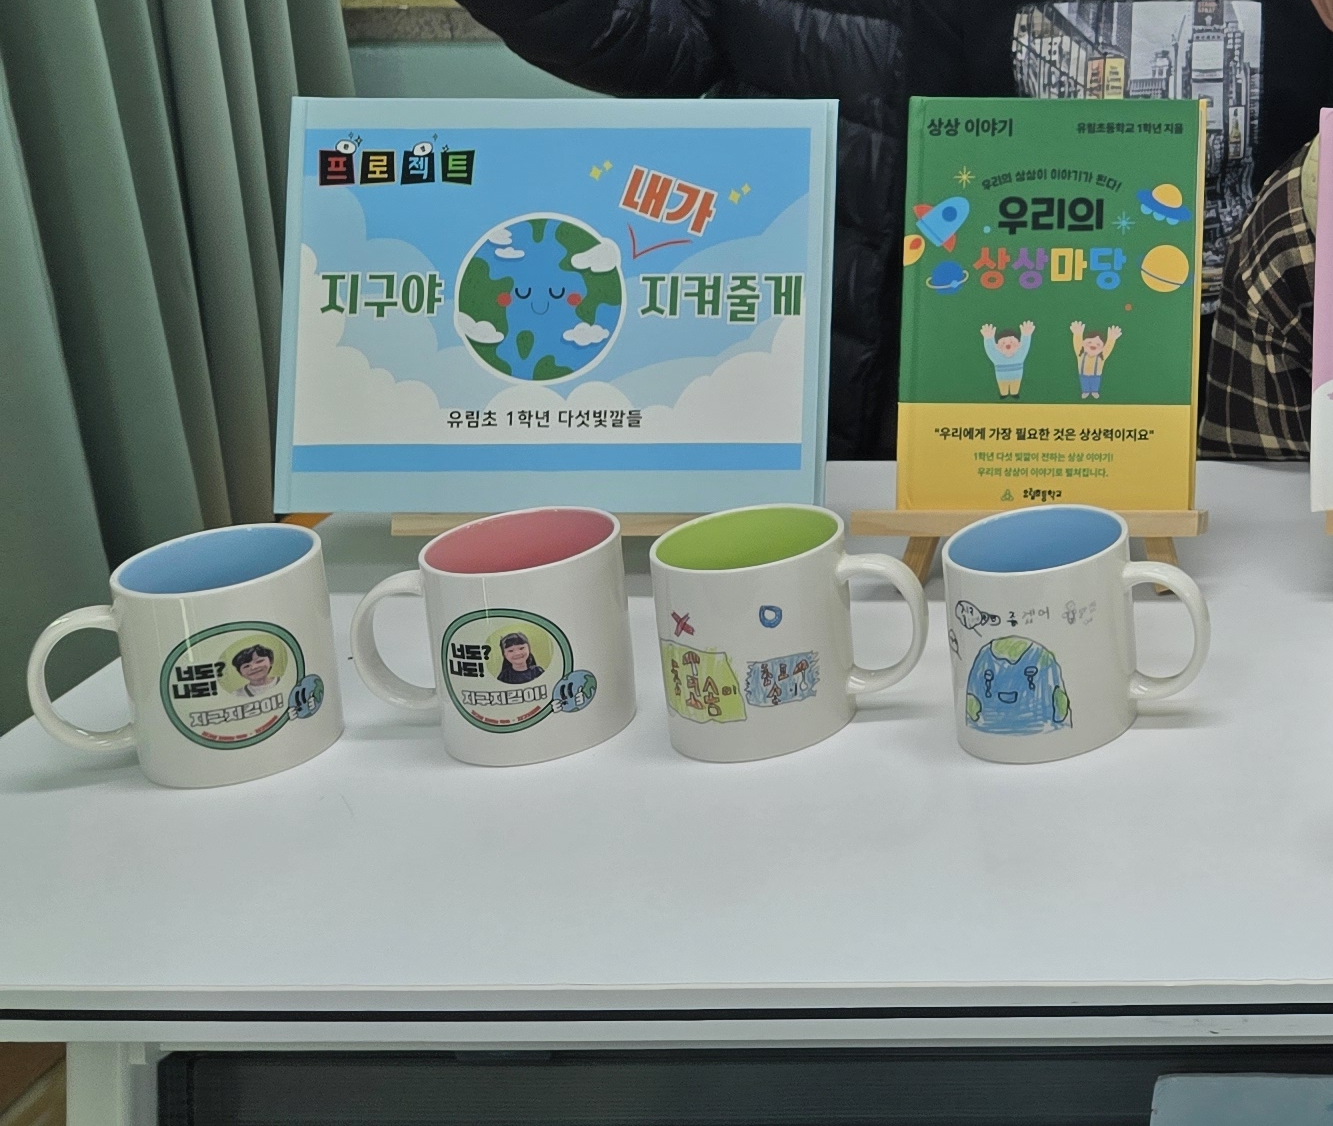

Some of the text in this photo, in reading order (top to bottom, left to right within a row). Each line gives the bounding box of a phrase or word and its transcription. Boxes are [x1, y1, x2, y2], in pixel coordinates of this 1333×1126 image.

[927, 118, 1013, 137] 상상 이야기
[1137, 122, 1162, 134] 1학년
[326, 154, 468, 180] 프로젝트
[982, 172, 1013, 191] 우리의
[1015, 168, 1048, 183] 상상이
[998, 196, 1104, 235] 우리의
[320, 164, 804, 324] 지구야 내가 지켜줄게
[972, 245, 1127, 291] 상상마당
[447, 409, 643, 428] 유림초 1학년 다섯빛깔들
[989, 428, 1012, 441] 가장
[1015, 428, 1050, 441] 필요한
[1053, 428, 1076, 441] 것은
[1067, 452, 1084, 462] 상상
[977, 467, 1002, 477] 우리의
[1004, 467, 1029, 477] 상상이
[451, 643, 492, 661] 너도?
[175, 661, 226, 682] 너도?
[449, 659, 485, 678] 나도!
[172, 681, 218, 699] 나도!
